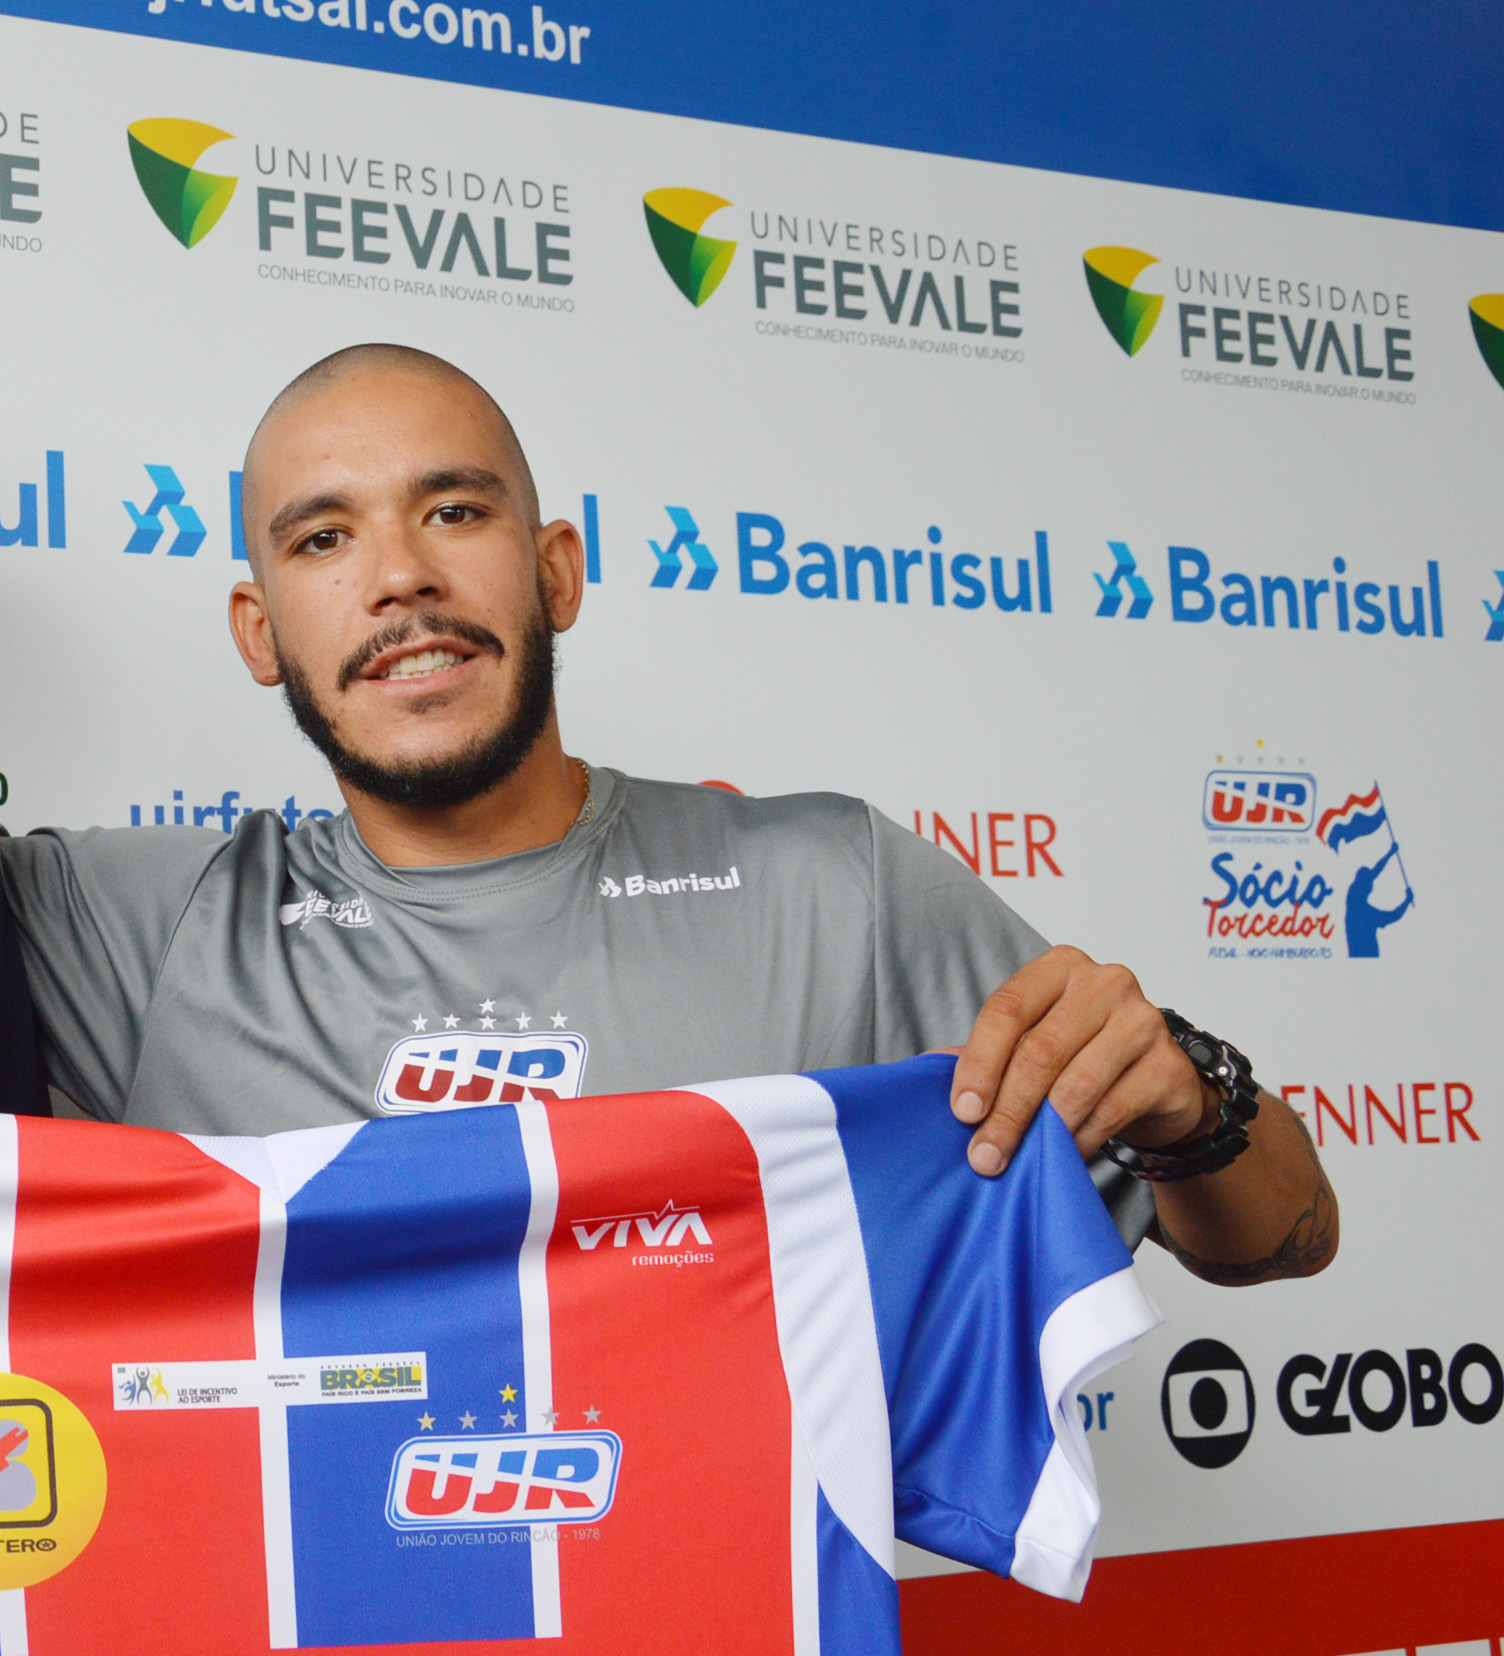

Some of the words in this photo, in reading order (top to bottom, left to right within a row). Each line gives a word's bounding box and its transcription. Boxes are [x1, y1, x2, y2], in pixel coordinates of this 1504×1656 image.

[255, 144, 570, 213] UNIVERSIDADE
[257, 186, 574, 286] FEEVALE
[751, 211, 1019, 272] UNIVERSIDADE
[257, 263, 391, 292] CONHECIMENTO
[394, 279, 437, 297] PARA
[440, 285, 497, 304] INOVAR
[501, 292, 514, 306] O
[517, 294, 575, 313] MUNDO
[753, 249, 1023, 338] FEEVALE
[1175, 267, 1411, 319] UNIVERSIDADE
[755, 320, 868, 346] CONHECIMENTO
[870, 332, 906, 350] PARA
[909, 337, 958, 356] INOVAR
[975, 346, 1025, 364] MUNDO
[1178, 303, 1414, 382] FEEVALE
[735, 511, 1052, 614] Banrisul
[1167, 545, 1444, 638] Banrisul
[1211, 781, 1307, 823] UJR
[914, 811, 1065, 877] NER
[625, 866, 741, 897] Banrisul
[1203, 852, 1335, 909] Sócio
[1203, 900, 1335, 940] Torcedor
[395, 1048, 566, 1103] UJR
[571, 1212, 713, 1251] VIVA
[632, 1250, 715, 1268] remoções
[177, 1388, 187, 1397] LEI
[189, 1388, 198, 1397] DE
[199, 1387, 238, 1396] INCENTIVO
[178, 1396, 189, 1404] AO
[190, 1395, 221, 1404] ESPORTE
[320, 1366, 422, 1391] BRASIL
[1276, 1342, 1504, 1436] GLOBO
[405, 1448, 600, 1516] UJR
[396, 1532, 436, 1547] UNIÃO
[440, 1532, 485, 1546] JOVEM
[488, 1532, 507, 1545] DO
[510, 1528, 560, 1543] RINCÃO
[572, 1528, 601, 1541] 1978
